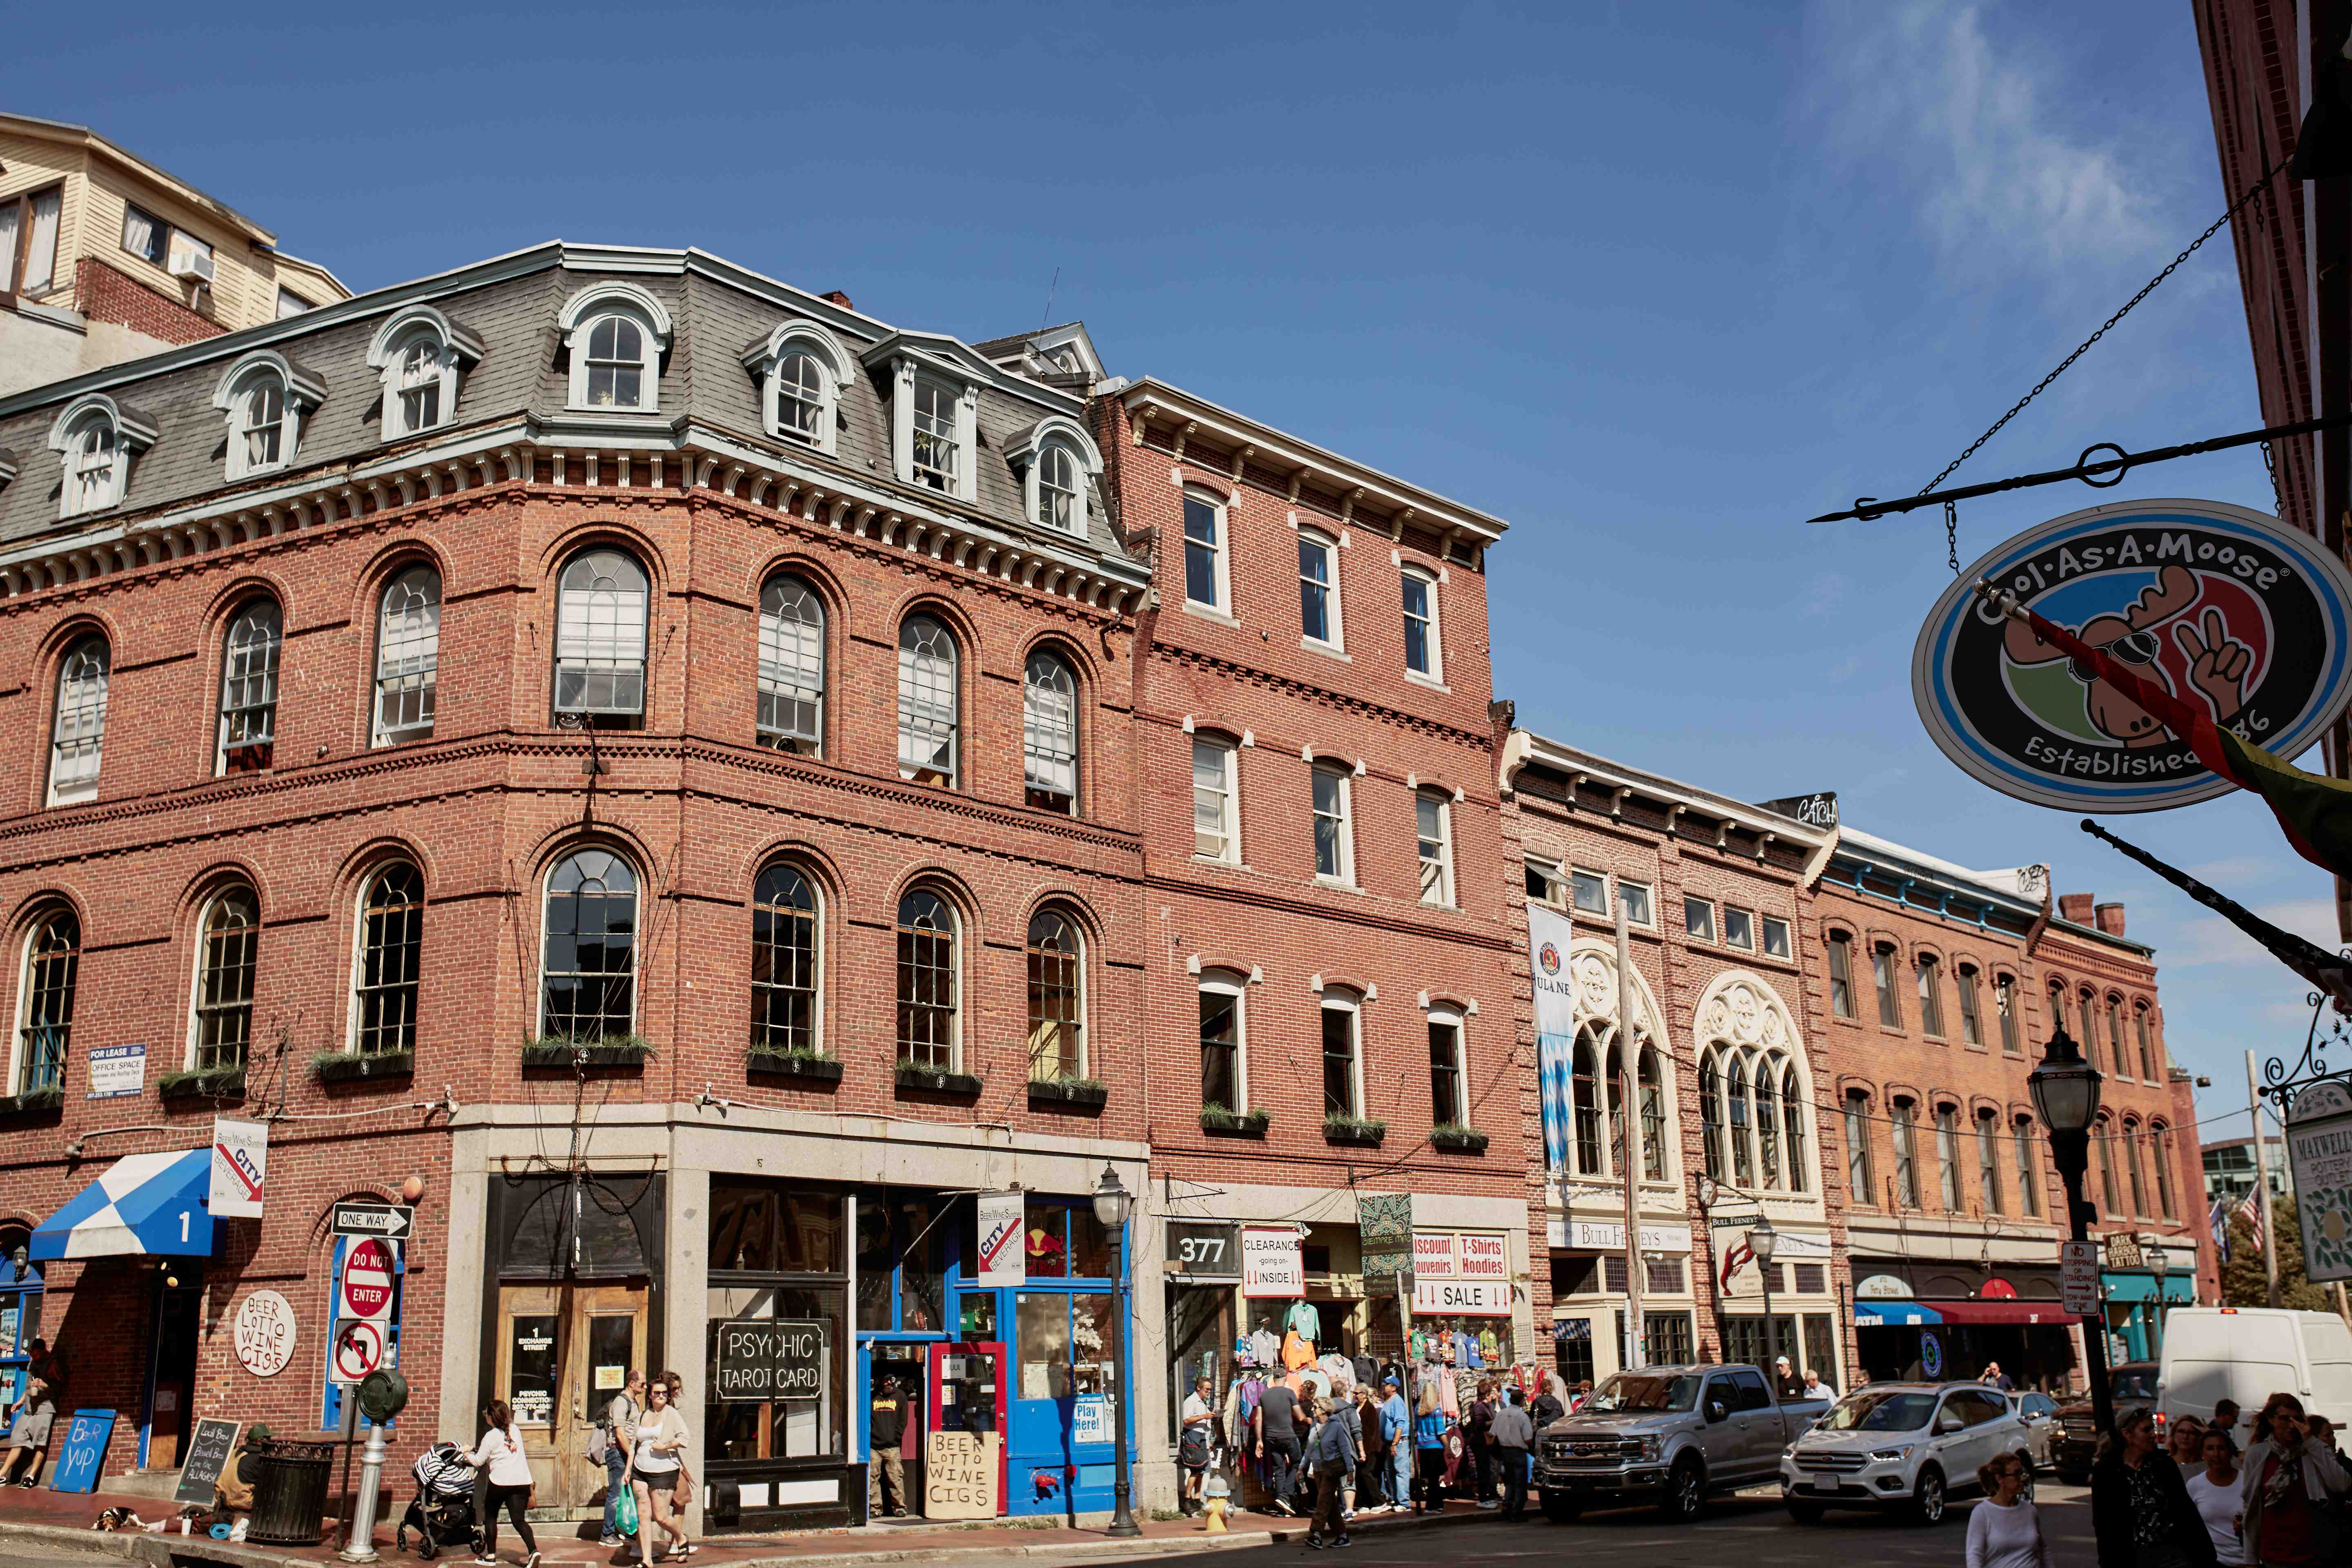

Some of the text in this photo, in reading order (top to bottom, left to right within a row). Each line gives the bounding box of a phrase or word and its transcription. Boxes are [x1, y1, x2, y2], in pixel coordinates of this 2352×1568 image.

[1977, 562, 2046, 626] Col
[90, 1049, 105, 1059] FOR
[105, 1047, 127, 1058] LEASE
[92, 1060, 141, 1071] OFFICE SPACE
[2297, 1130, 2352, 1161] MAXWELL'
[235, 1148, 262, 1183] CITY
[214, 1153, 250, 1201] BEVERAGE
[178, 1211, 190, 1243] 1
[341, 1213, 388, 1227] ONE WAY
[980, 1221, 1005, 1256] CITY
[1362, 1236, 1394, 1245] SIEMPRE
[1581, 1224, 1661, 1246] BULL FEEY'S
[2110, 1234, 2132, 1247] DARK
[990, 1227, 1022, 1271] BEVERAGE
[1179, 1238, 1225, 1262] 377
[1244, 1240, 1301, 1251] CLEARANCE
[1414, 1238, 1451, 1254] iscount
[1461, 1238, 1501, 1255] T-Shirts
[2071, 1247, 2085, 1257] NO
[2107, 1244, 2139, 1258] HARBOR
[353, 1252, 389, 1268] DO NOT
[1416, 1259, 1451, 1274] ouvenirs
[1462, 1257, 1503, 1274] Hoodies
[2110, 1255, 2140, 1268] TATTOO
[1259, 1273, 1289, 1283] INSIDE
[2064, 1274, 2095, 1282] STANDING
[353, 1288, 382, 1303] ENTER
[1444, 1287, 1483, 1306] SALE
[248, 1297, 279, 1319] BEER
[1854, 1315, 1883, 1327] ATM
[532, 1327, 539, 1338] 1
[242, 1329, 284, 1356] WINE
[730, 1332, 813, 1358] PSYCHIC
[722, 1368, 818, 1389] TAROT CARD
[1077, 1405, 1096, 1418] Play
[1075, 1417, 1100, 1430] Here!
[935, 1434, 982, 1453] BEER
[930, 1452, 982, 1466] LOTTO
[929, 1465, 987, 1485] WINE
[929, 1485, 987, 1507] CIGS
